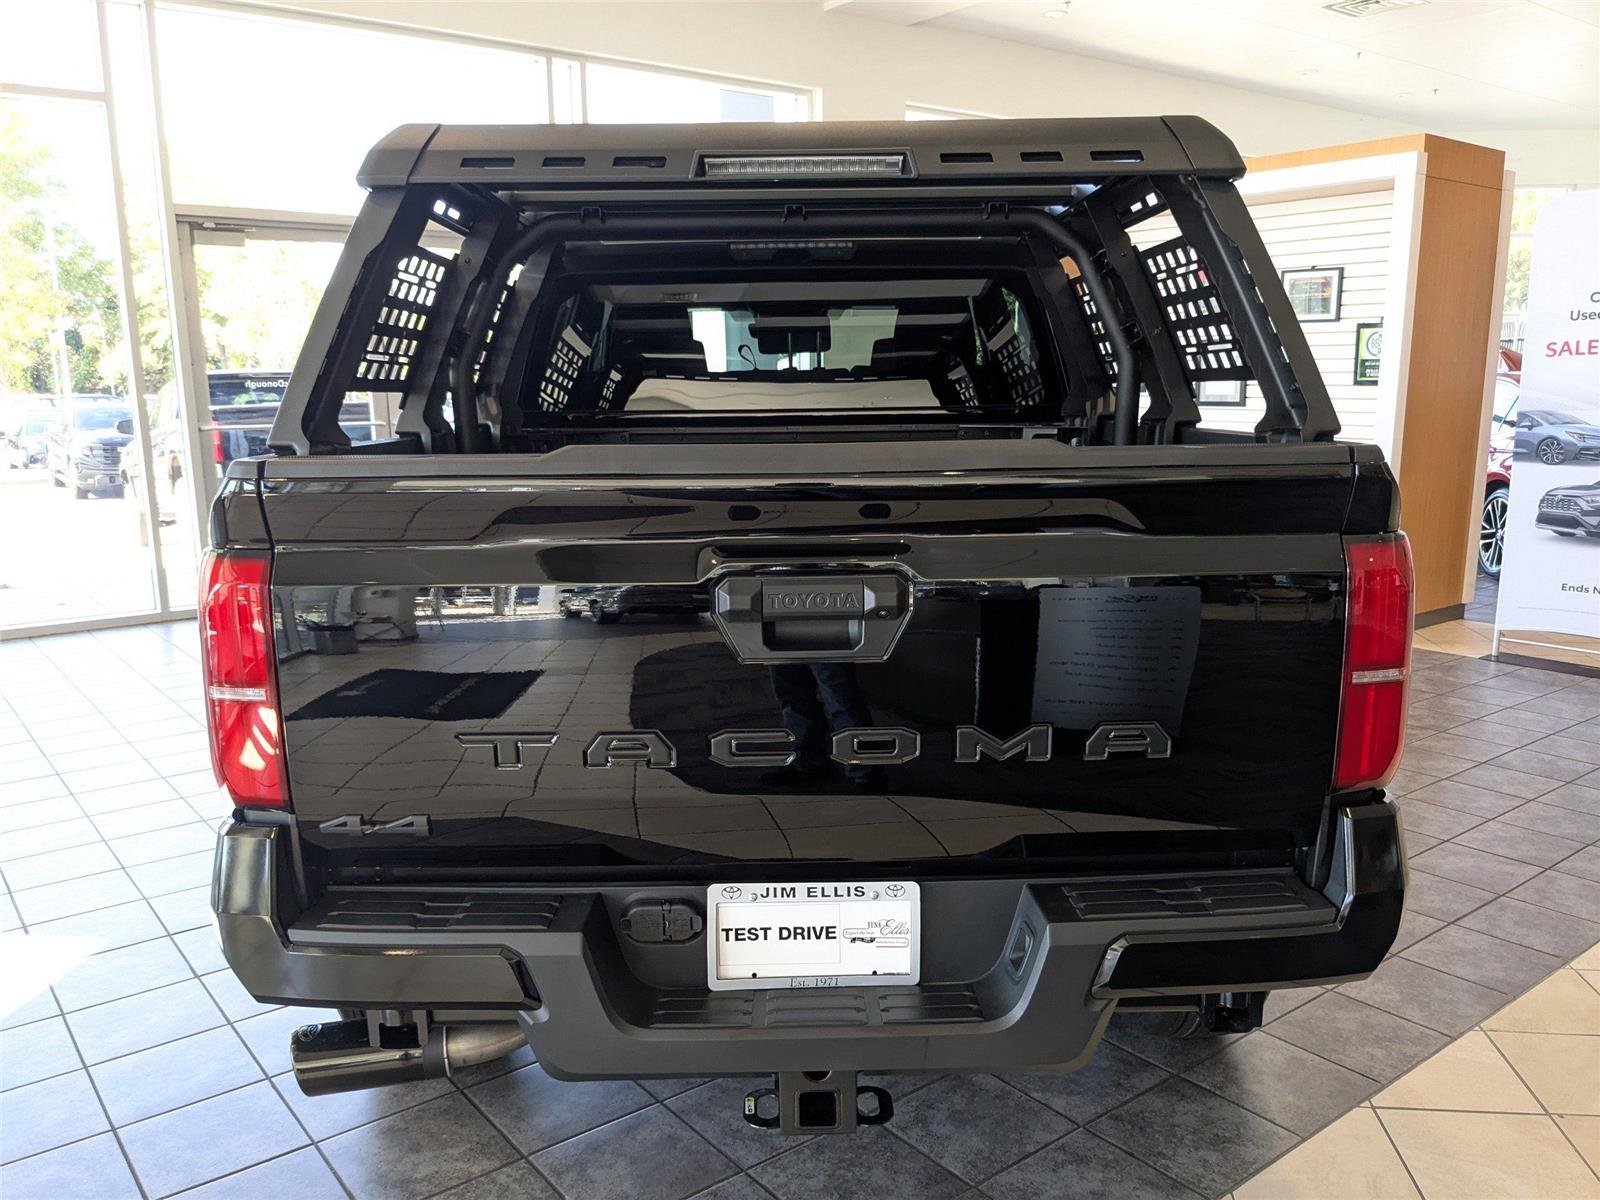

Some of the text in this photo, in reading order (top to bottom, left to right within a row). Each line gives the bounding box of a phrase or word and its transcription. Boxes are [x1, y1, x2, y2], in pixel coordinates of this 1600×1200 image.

[1545, 339, 1599, 358] SALE
[1561, 583, 1590, 594] Ends
[768, 591, 861, 609] TOYOTA
[455, 721, 1172, 770] TACOMA
[760, 885, 866, 899] JIM ELLIS
[721, 925, 837, 942] TEST DRIVE
[867, 918, 910, 936] JIM Ellis
[789, 977, 840, 987] Est. 1971
